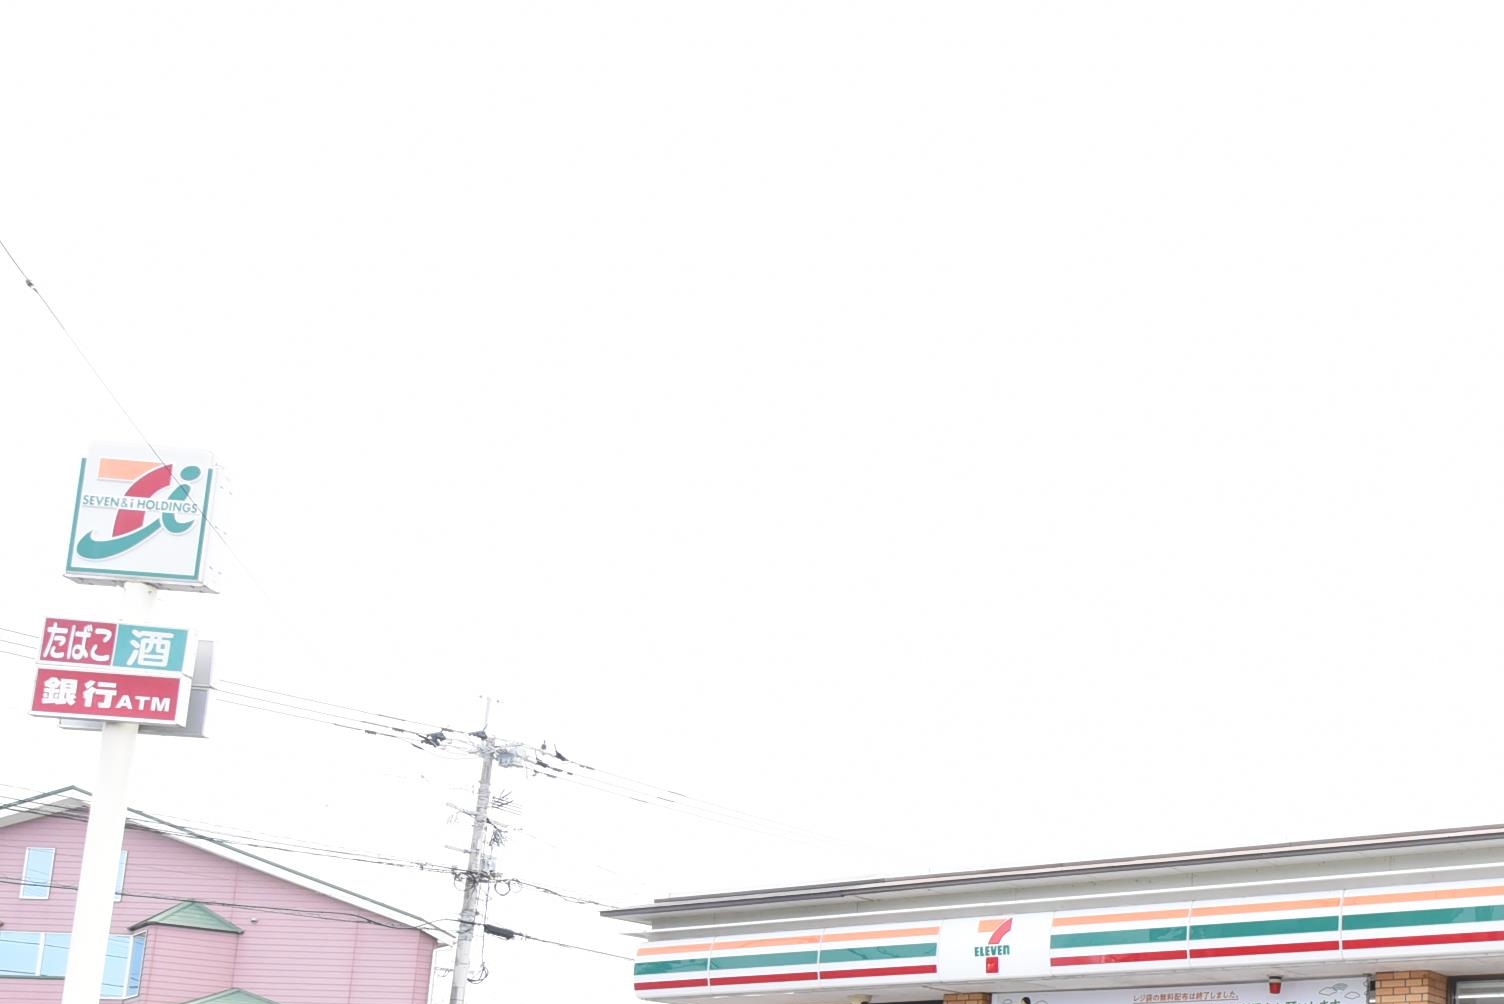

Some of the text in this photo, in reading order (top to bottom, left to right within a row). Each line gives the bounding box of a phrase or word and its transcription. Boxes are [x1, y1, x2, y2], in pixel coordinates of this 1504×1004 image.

[137, 500, 198, 513] HOLDINGS
[43, 622, 113, 662] たばこ
[126, 629, 174, 667] 酒
[41, 677, 171, 712] 銀行ATM
[1133, 990, 1239, 1002] レジ袋の無料配布は終了しました。
